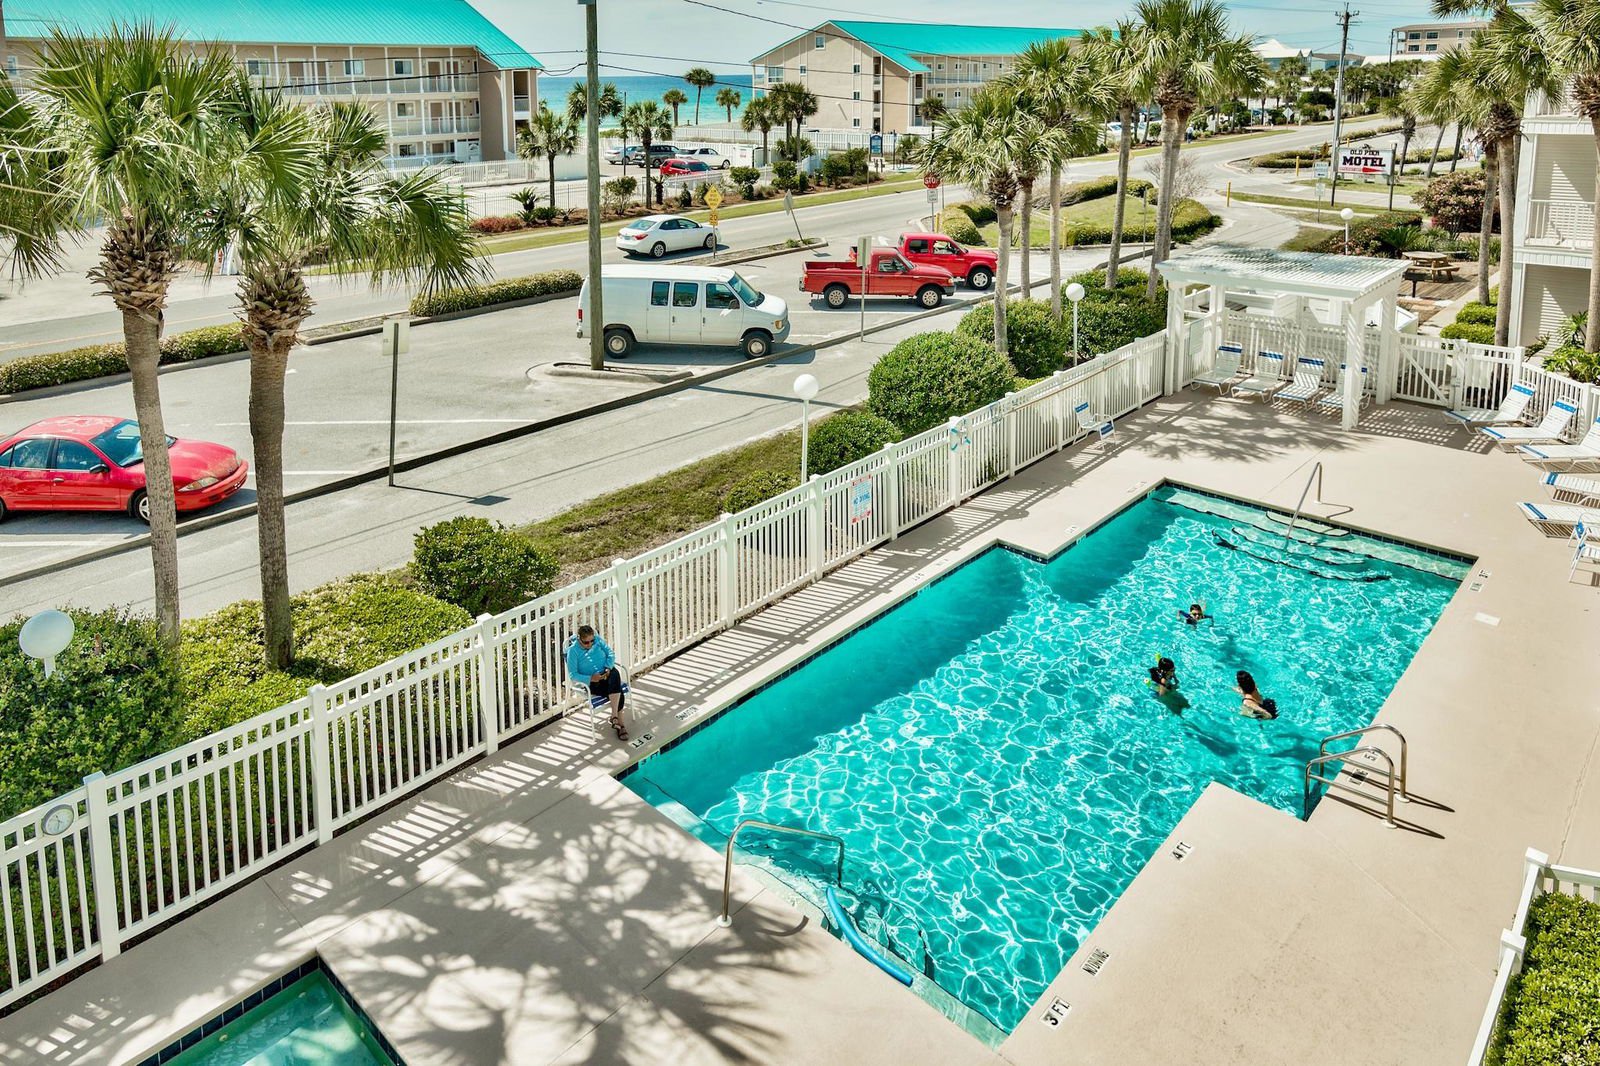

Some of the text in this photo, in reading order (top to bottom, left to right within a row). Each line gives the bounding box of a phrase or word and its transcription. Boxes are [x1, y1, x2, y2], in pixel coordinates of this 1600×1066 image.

[1342, 156, 1386, 167] MOTEL
[631, 739, 645, 749] FT
[1172, 842, 1192, 861] 4 FT
[1043, 1010, 1060, 1026] 3
